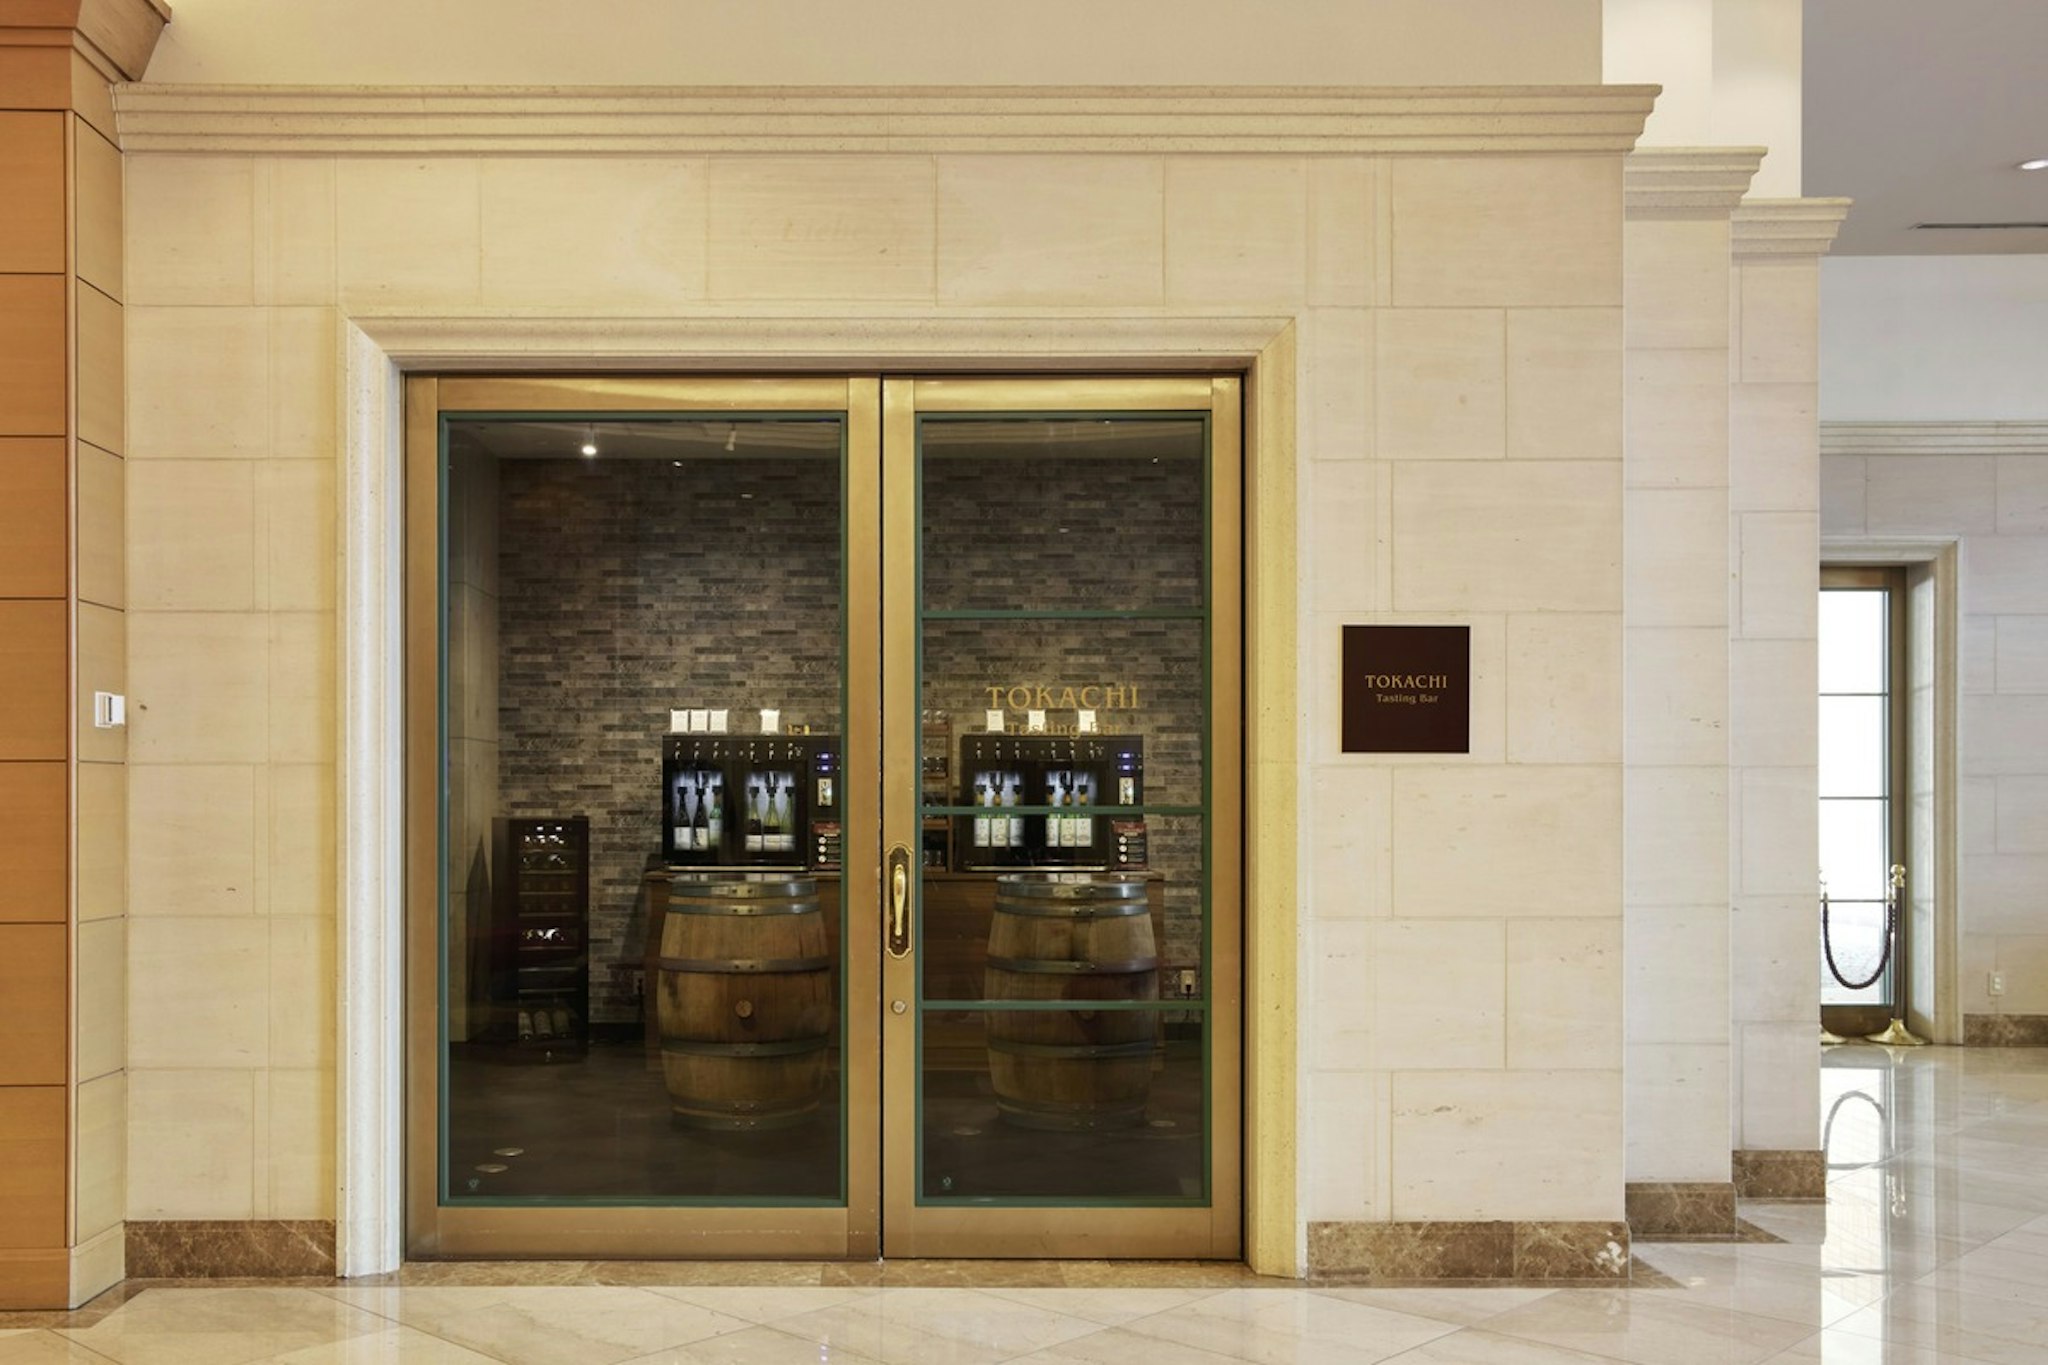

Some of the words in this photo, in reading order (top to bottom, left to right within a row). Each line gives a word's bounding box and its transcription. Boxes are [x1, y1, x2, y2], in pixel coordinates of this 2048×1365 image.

[1365, 675, 1447, 688] TOKACHI
[985, 686, 1138, 709] TOKACHI
[1376, 693, 1416, 705] Tasting
[1419, 693, 1439, 703] Bar
[1007, 721, 1080, 739] Tasting
